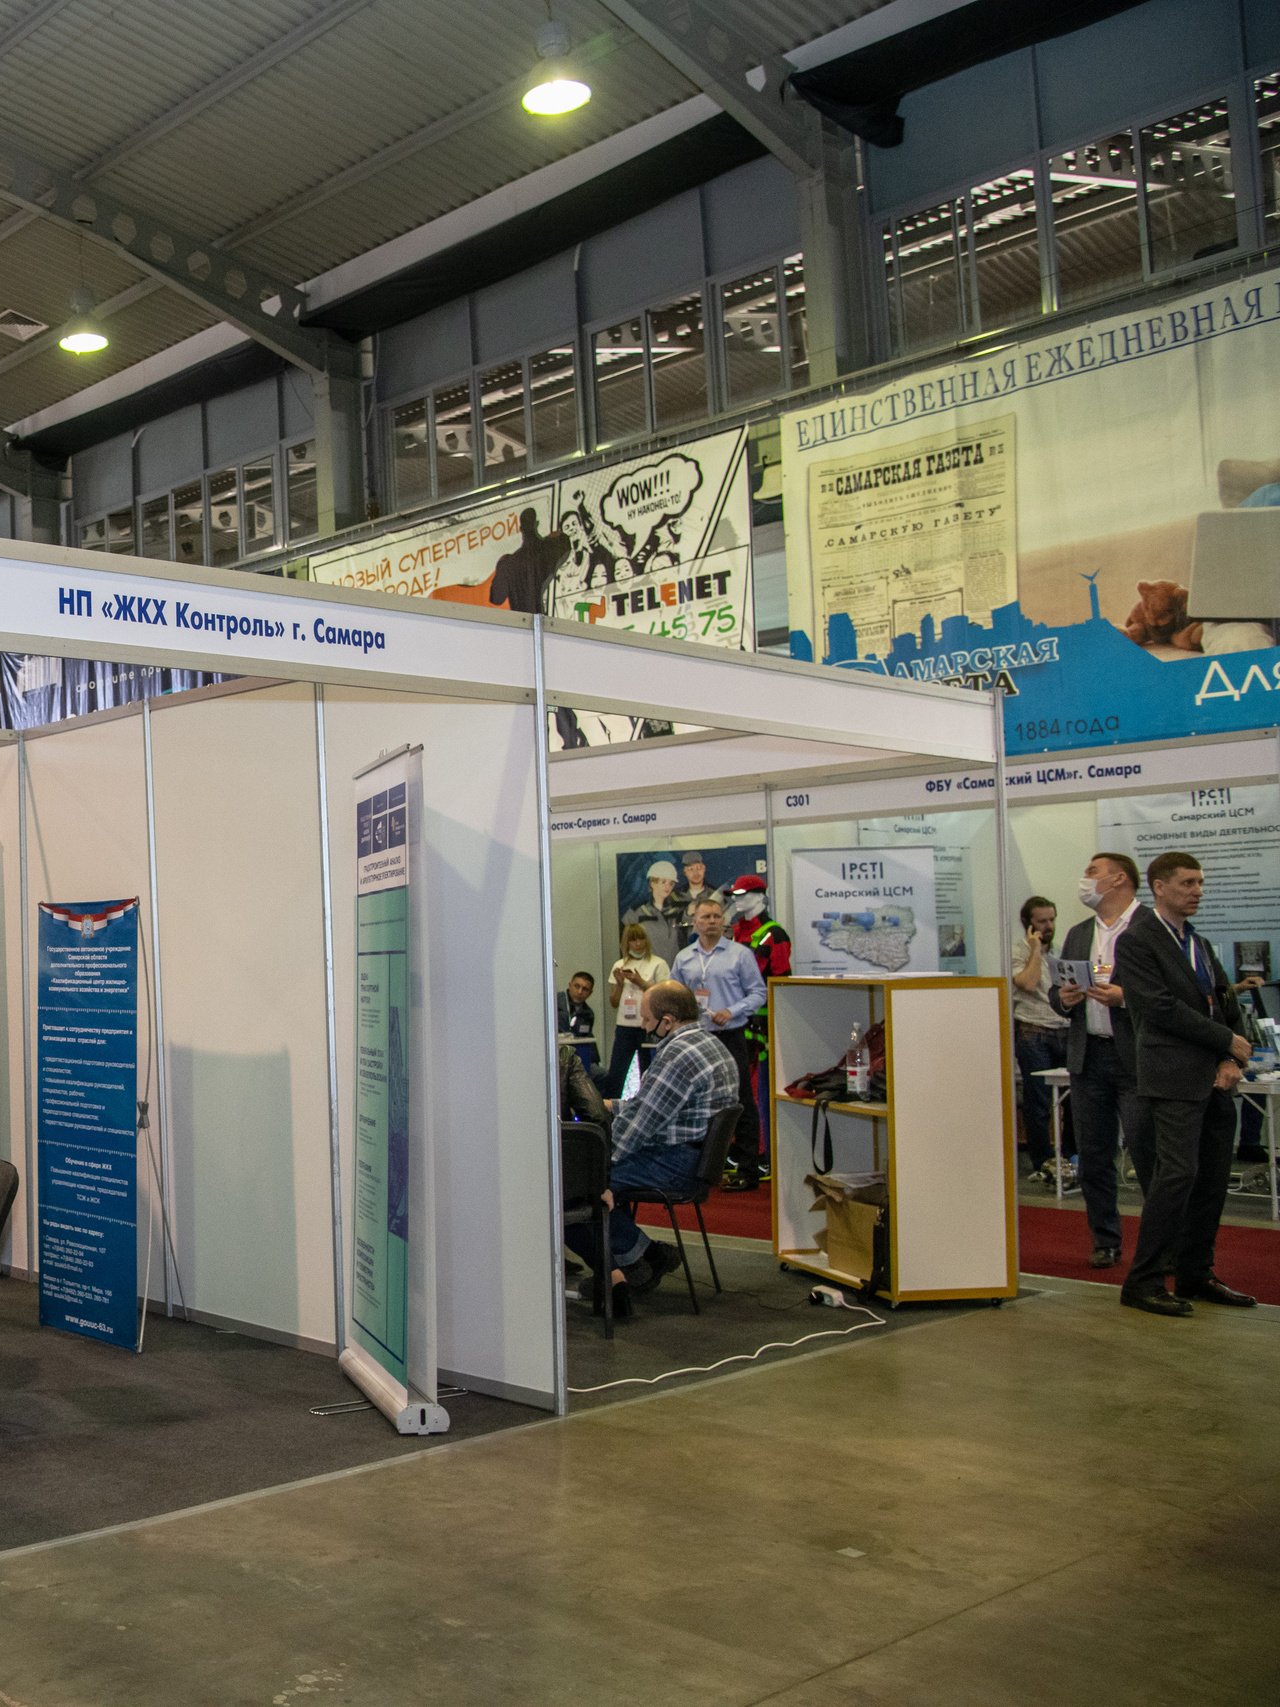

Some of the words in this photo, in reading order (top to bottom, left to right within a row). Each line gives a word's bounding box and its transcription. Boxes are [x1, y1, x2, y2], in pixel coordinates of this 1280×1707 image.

[796, 358, 1018, 449] ЕДИНСТВЕННАЯ
[1025, 286, 1263, 384] ЕЖЕДНЕВНАЯ
[836, 458, 922, 496] САМАРСКАЯ
[926, 443, 985, 476] ГАЗЕТА
[616, 470, 671, 509] WOW!!!
[398, 512, 521, 573] СУПЕРГЕРОЙ
[376, 567, 441, 597] РОДЕ!
[611, 570, 732, 617] TELENET
[58, 587, 92, 618] НП
[101, 593, 168, 626] «ЖКХ
[175, 602, 285, 641] Контроль»
[293, 622, 306, 641] г.
[313, 617, 386, 653] Самара
[698, 605, 736, 637] 75
[1016, 718, 1060, 741] 1884
[1066, 714, 1119, 739] года
[925, 778, 952, 793] ФБУ
[956, 771, 1032, 791] «Самакий
[1088, 763, 1142, 779] Самара
[613, 815, 620, 825] г.
[622, 812, 657, 824] Самара
[1171, 811, 1226, 822] Самарский
[1229, 807, 1254, 818] ЦСМ
[1137, 830, 1188, 842] ОСНОВНЫЕ
[1190, 829, 1217, 839] ВИДЫ
[815, 887, 880, 899] Самарский
[883, 886, 913, 898] ЦСМ
